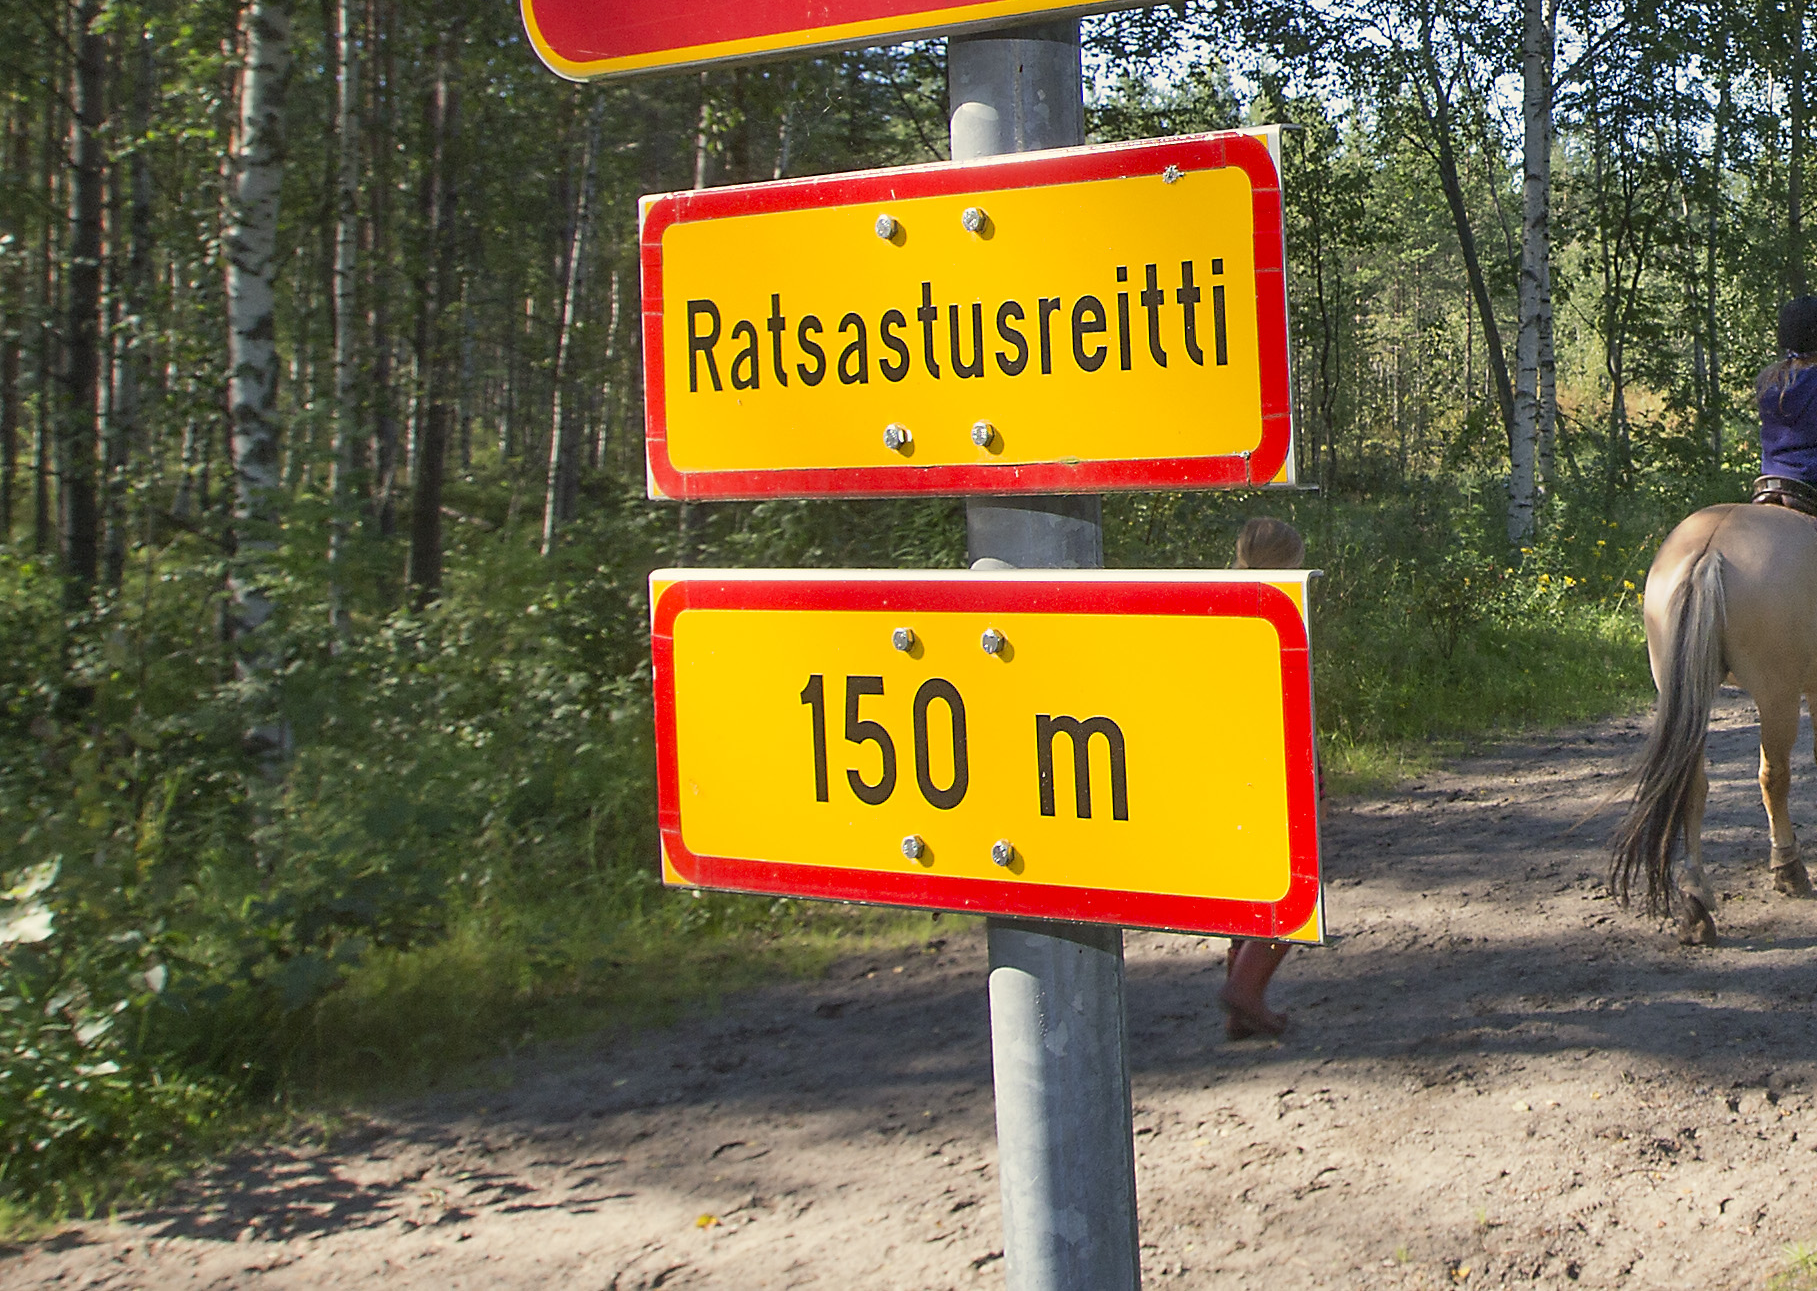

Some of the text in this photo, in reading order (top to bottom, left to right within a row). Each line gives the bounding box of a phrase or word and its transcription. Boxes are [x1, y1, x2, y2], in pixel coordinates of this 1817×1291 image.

[686, 257, 1229, 393] Ratsastusreitti
[799, 674, 1129, 822] 150 m
